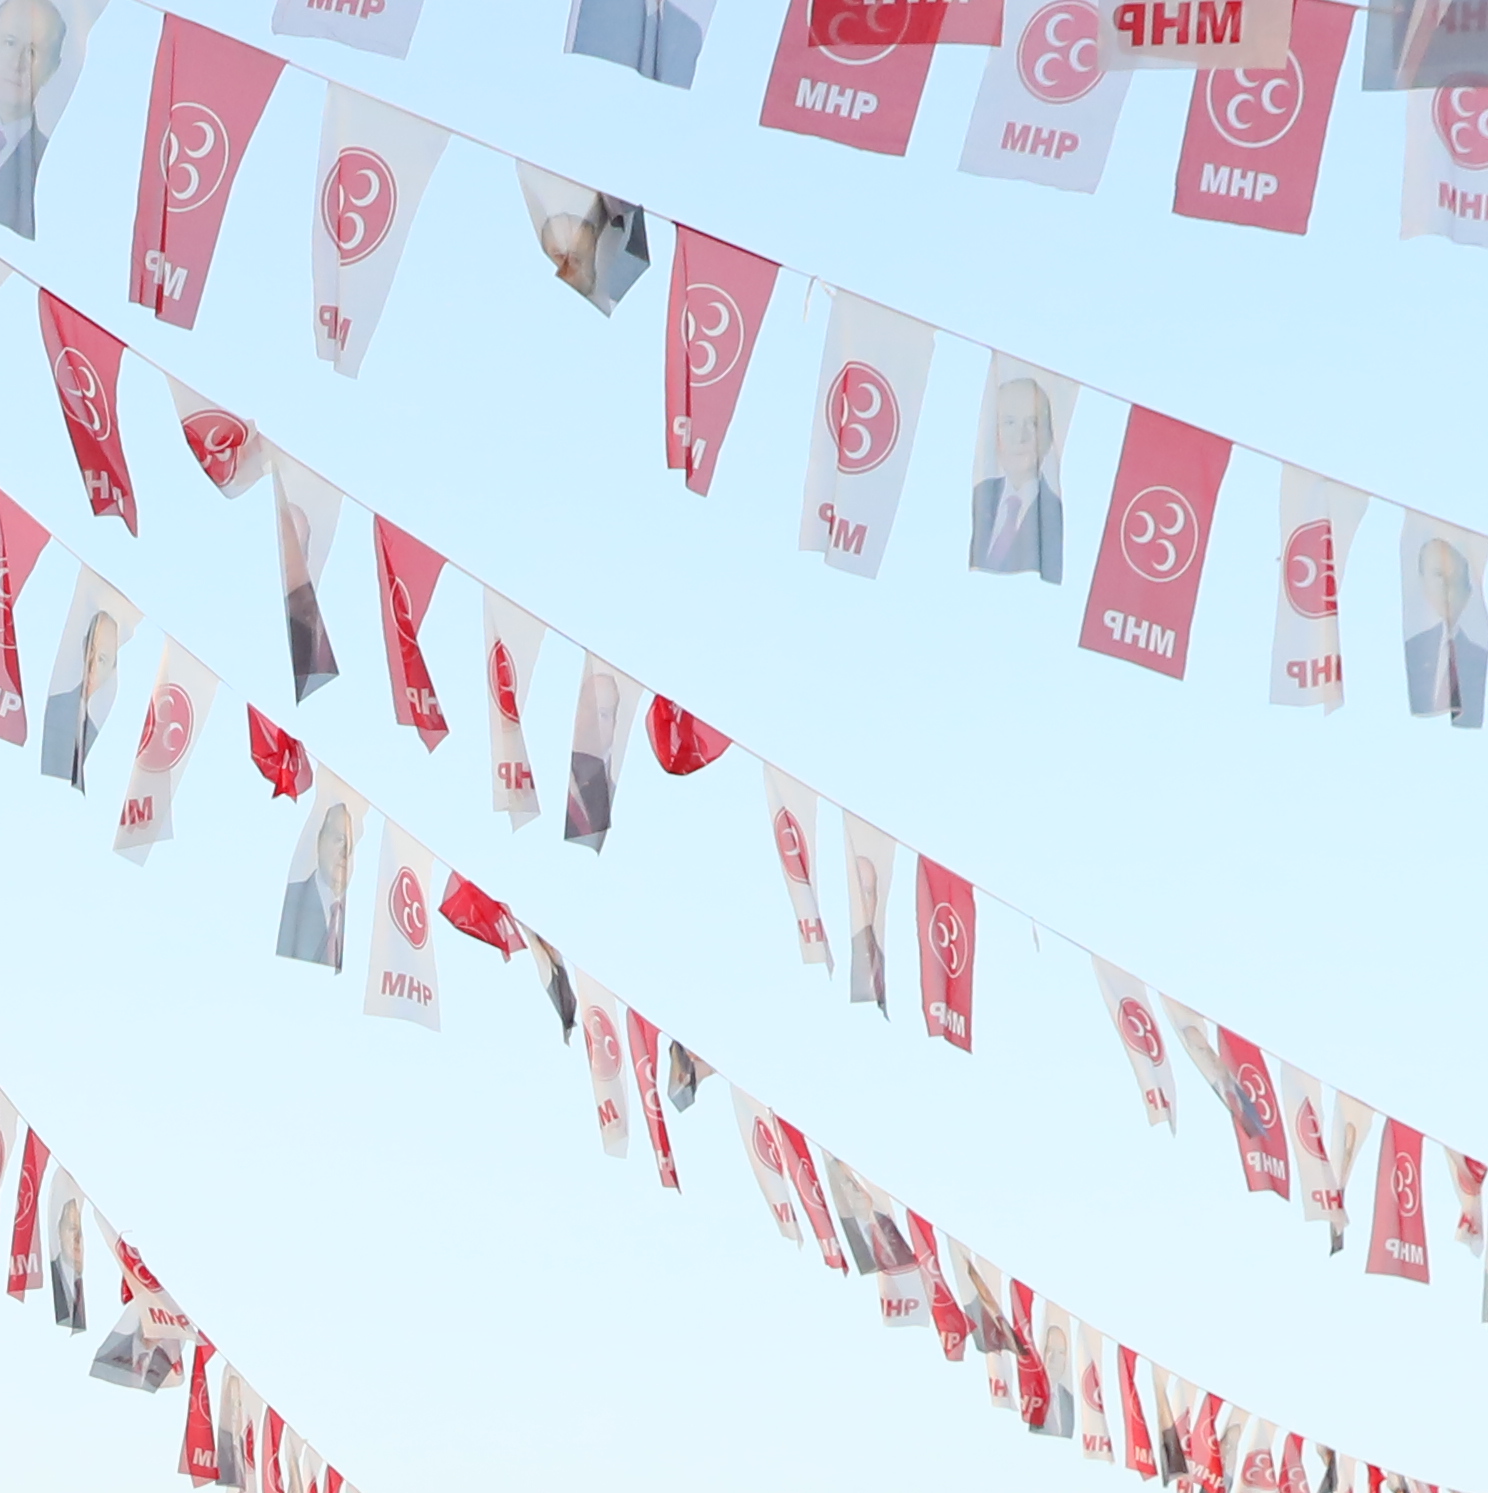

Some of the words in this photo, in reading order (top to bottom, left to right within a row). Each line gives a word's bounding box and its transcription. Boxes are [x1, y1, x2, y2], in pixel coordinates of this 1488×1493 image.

[795, 77, 878, 121] MHP
[1000, 122, 1080, 161] MHP
[1200, 163, 1279, 203] MHP
[381, 970, 434, 1008] MHP
